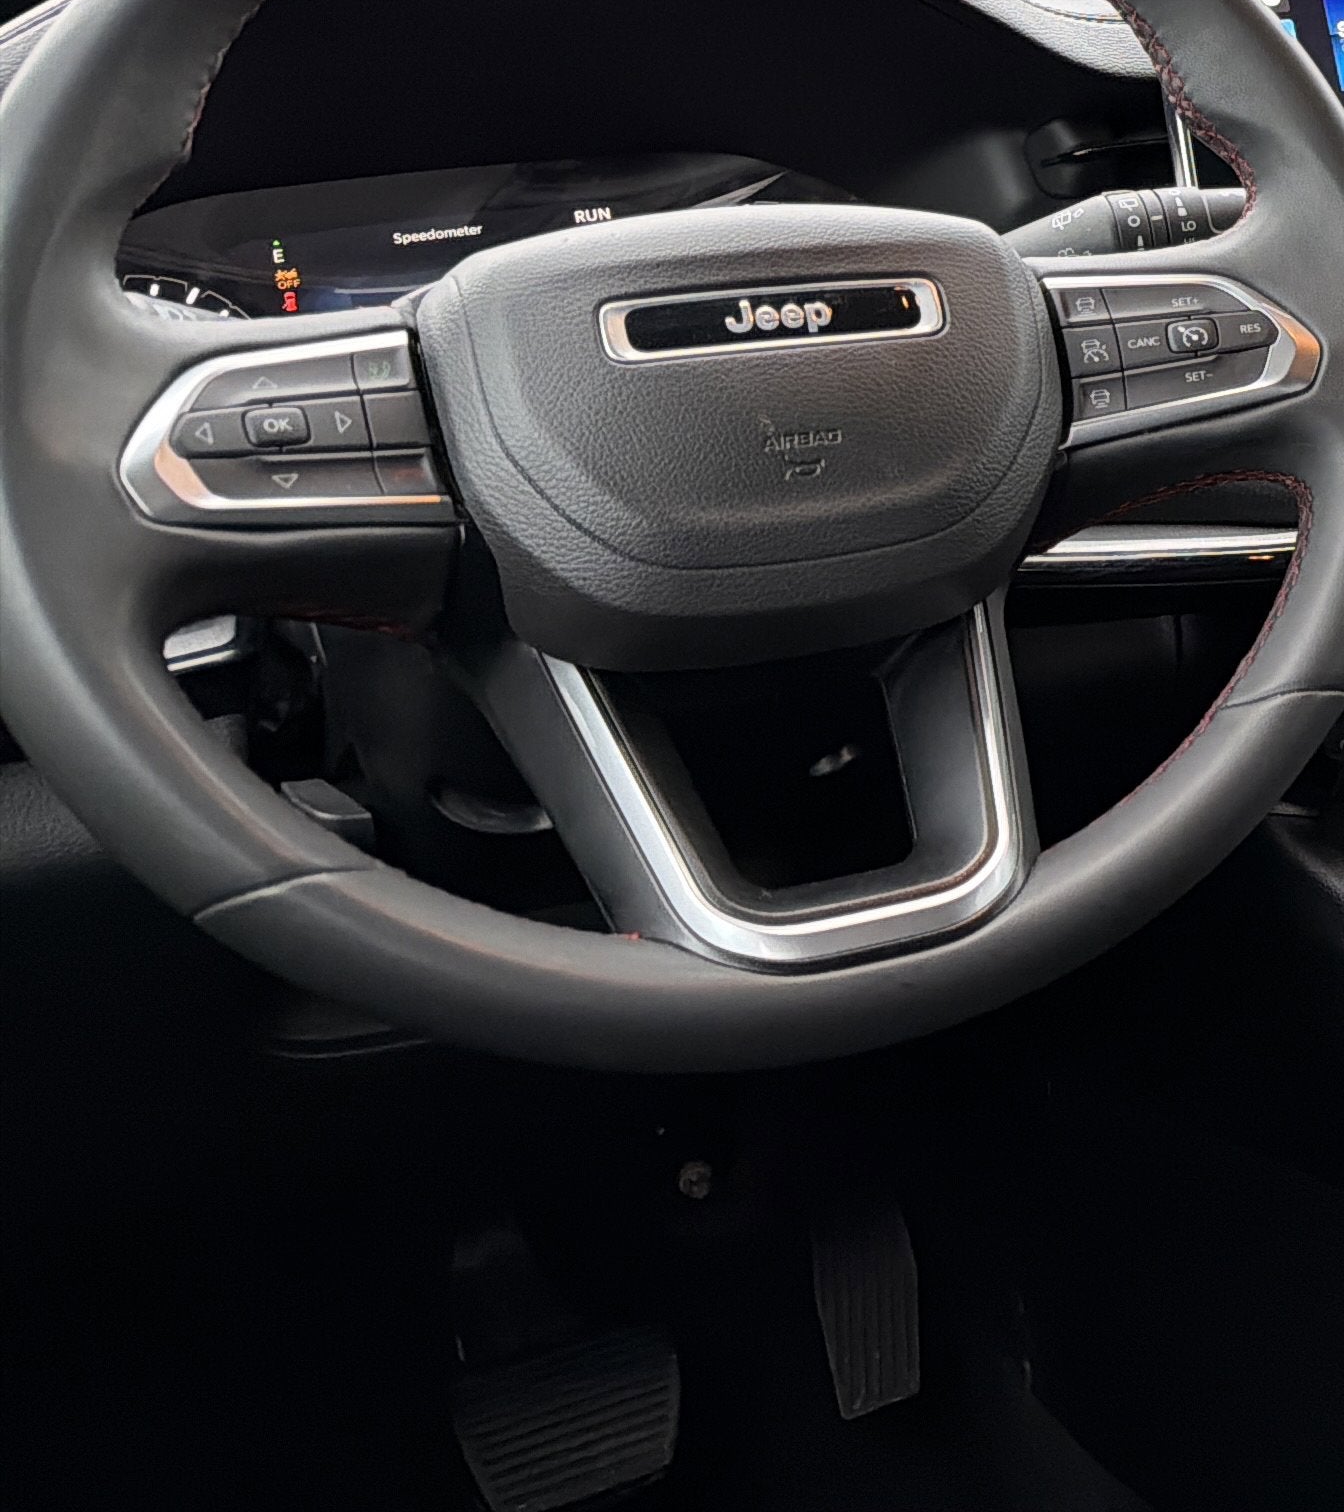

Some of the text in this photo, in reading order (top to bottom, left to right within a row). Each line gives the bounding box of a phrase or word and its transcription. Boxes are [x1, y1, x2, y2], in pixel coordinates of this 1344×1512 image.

[573, 207, 612, 224] RUN
[1181, 220, 1197, 232] LO
[392, 223, 484, 247] Speedometer
[272, 248, 285, 264] E
[277, 278, 300, 291] OFF
[1170, 296, 1200, 309] SET+
[724, 299, 833, 334] Jeep
[1239, 322, 1263, 334] RES
[1127, 335, 1162, 350] CANC
[262, 415, 292, 434] OK
[764, 429, 843, 453] AIRBAG
